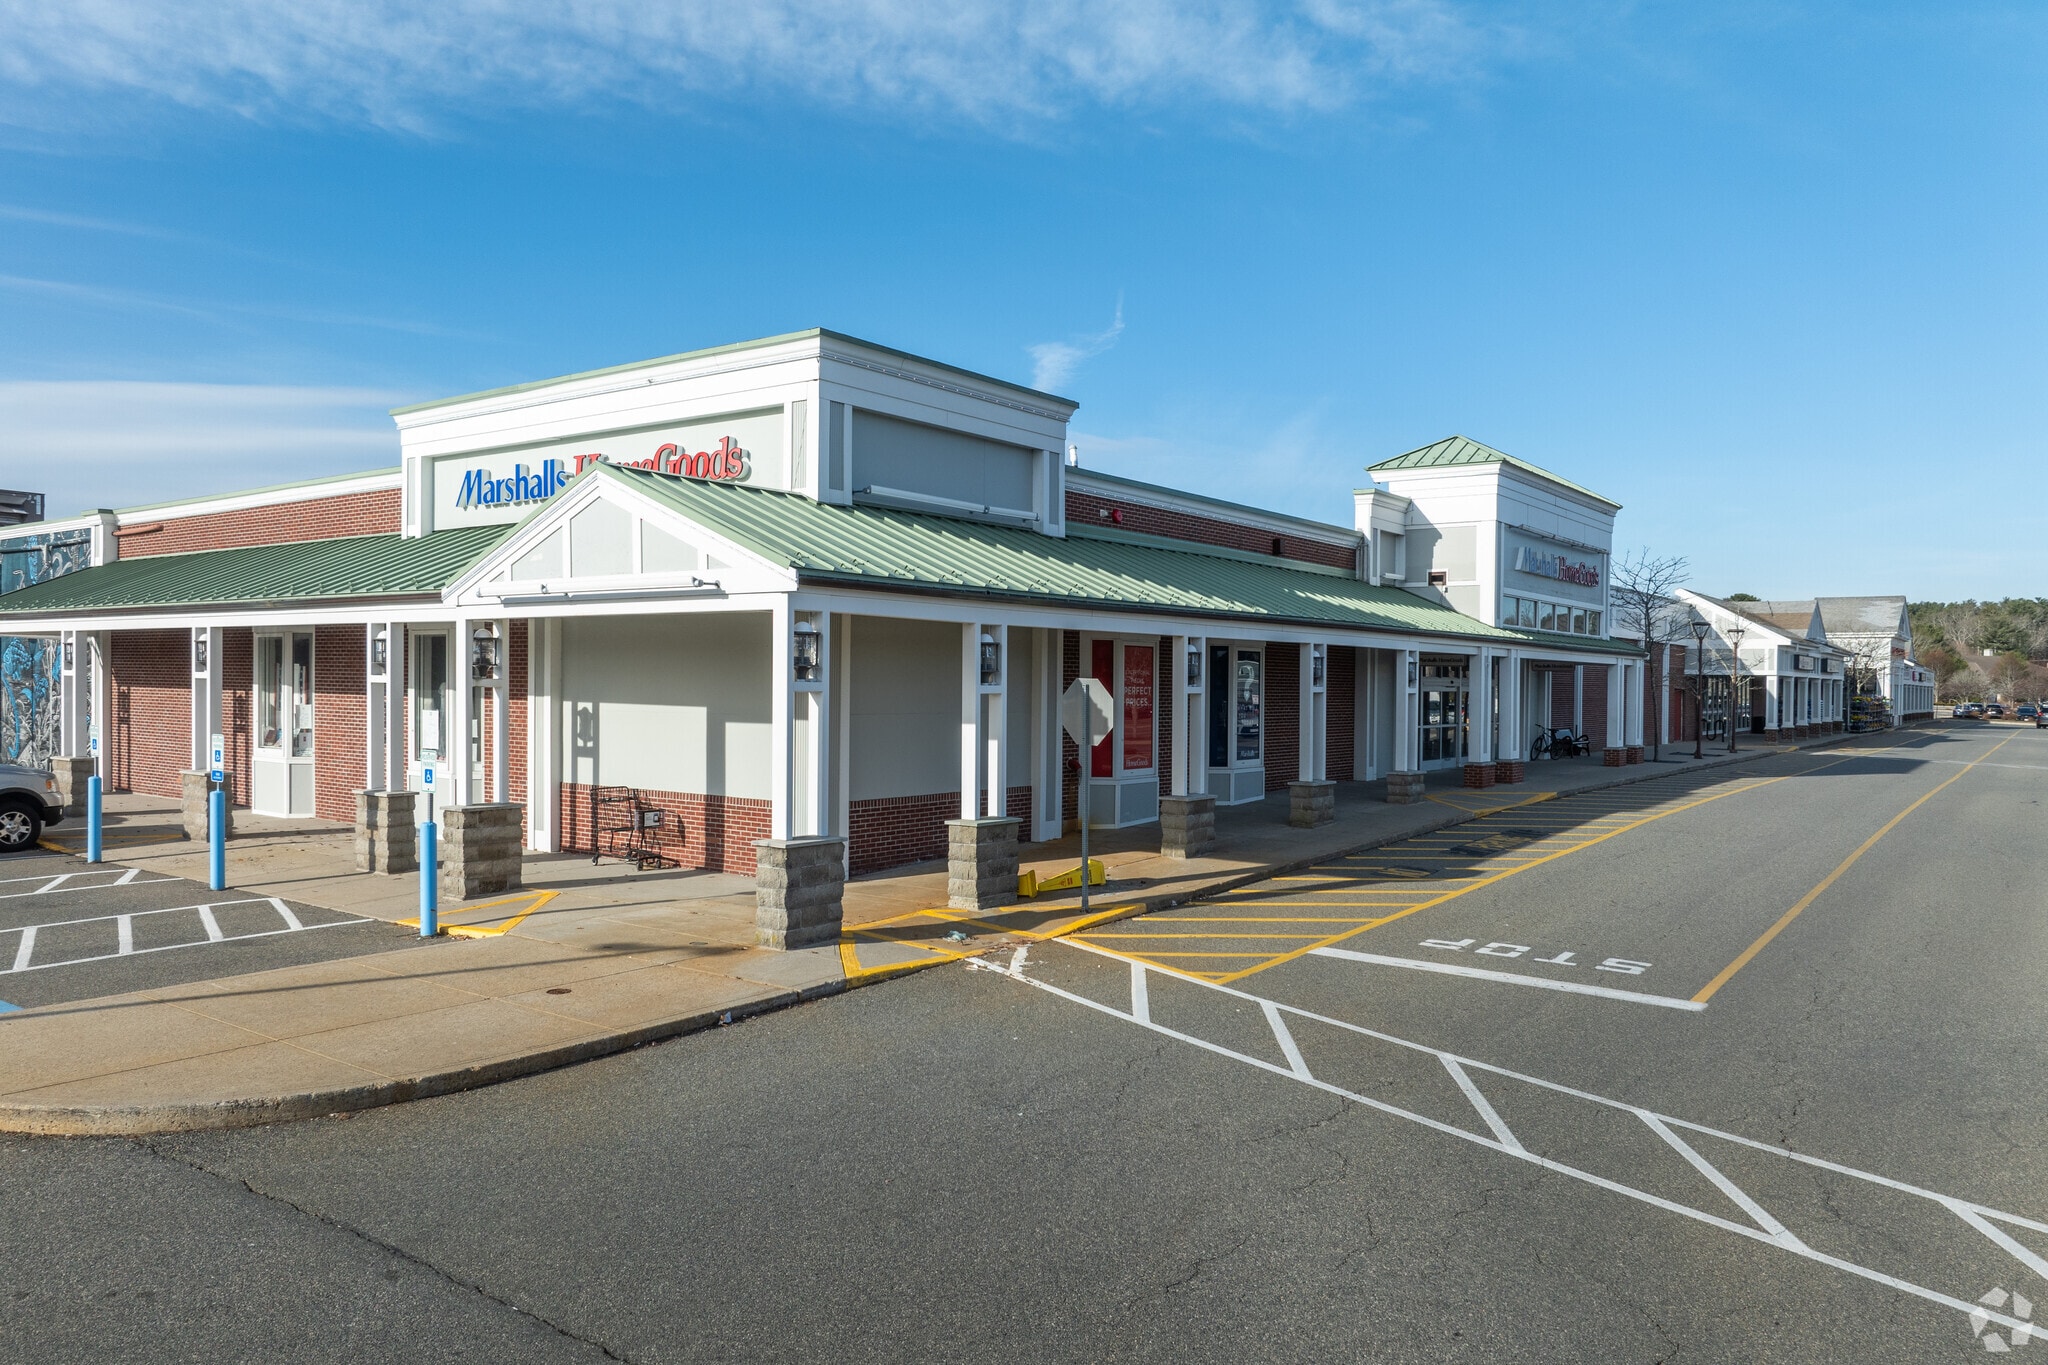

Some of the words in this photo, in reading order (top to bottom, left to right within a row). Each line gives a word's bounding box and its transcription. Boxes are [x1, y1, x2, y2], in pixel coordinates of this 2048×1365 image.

[456, 459, 566, 508] Marshalls
[573, 435, 743, 480] Goods
[1418, 939, 1653, 975] STOP
